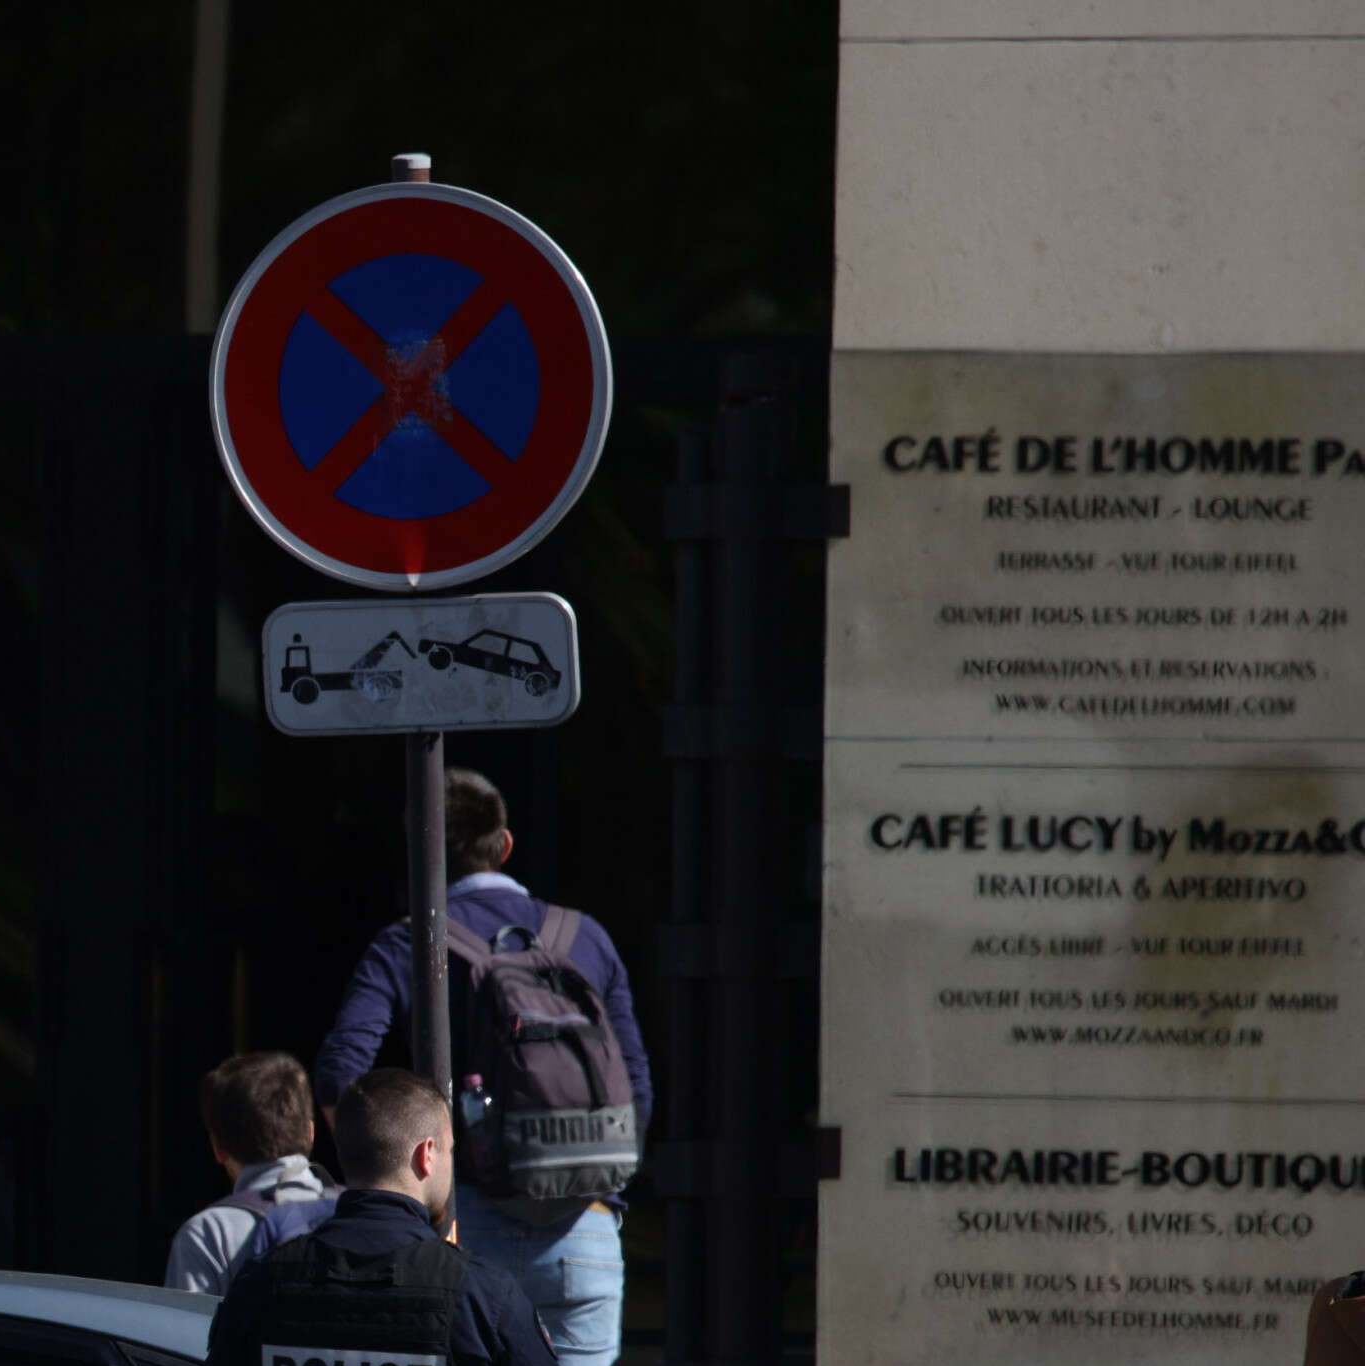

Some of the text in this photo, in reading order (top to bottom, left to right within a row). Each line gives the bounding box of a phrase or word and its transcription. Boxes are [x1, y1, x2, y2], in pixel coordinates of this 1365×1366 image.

[883, 426, 1001, 473] CAFÉ
[1016, 435, 1077, 473] DE
[1091, 436, 1301, 475] L'HOMME
[986, 495, 1162, 520] RESTAURANT
[1194, 496, 1312, 522] LOUNGE
[1168, 553, 1227, 573] TOUR
[939, 605, 1022, 626] OUVERT
[1030, 606, 1084, 626] TOUS
[1092, 606, 1129, 626] LES
[1134, 607, 1202, 627] JOURS
[1210, 608, 1237, 627] DE
[1317, 608, 1348, 628] 2H
[962, 659, 1123, 679] INFORMATIONS
[1130, 660, 1153, 679] ET
[869, 805, 989, 852] CAFÉ
[1000, 814, 1123, 853] LUCY
[1131, 815, 1179, 862] by
[977, 874, 1122, 899] TRATTORIA
[1162, 876, 1307, 902] APERITIVO
[1177, 937, 1234, 956] TOUR
[938, 988, 1339, 1012] OUVERT TOUS LES JOURS SAUF MARDI
[519, 1115, 604, 1145] PUMA
[893, 1147, 1365, 1193] LIBRAIRIE-BOUTIQU
[1234, 1210, 1315, 1238] DÉCO
[933, 1271, 1014, 1292] OUVERT
[1023, 1273, 1077, 1292] TOUS
[1085, 1275, 1121, 1293] LES
[1127, 1275, 1194, 1294] JOURS
[1203, 1277, 1254, 1296] SAUF
